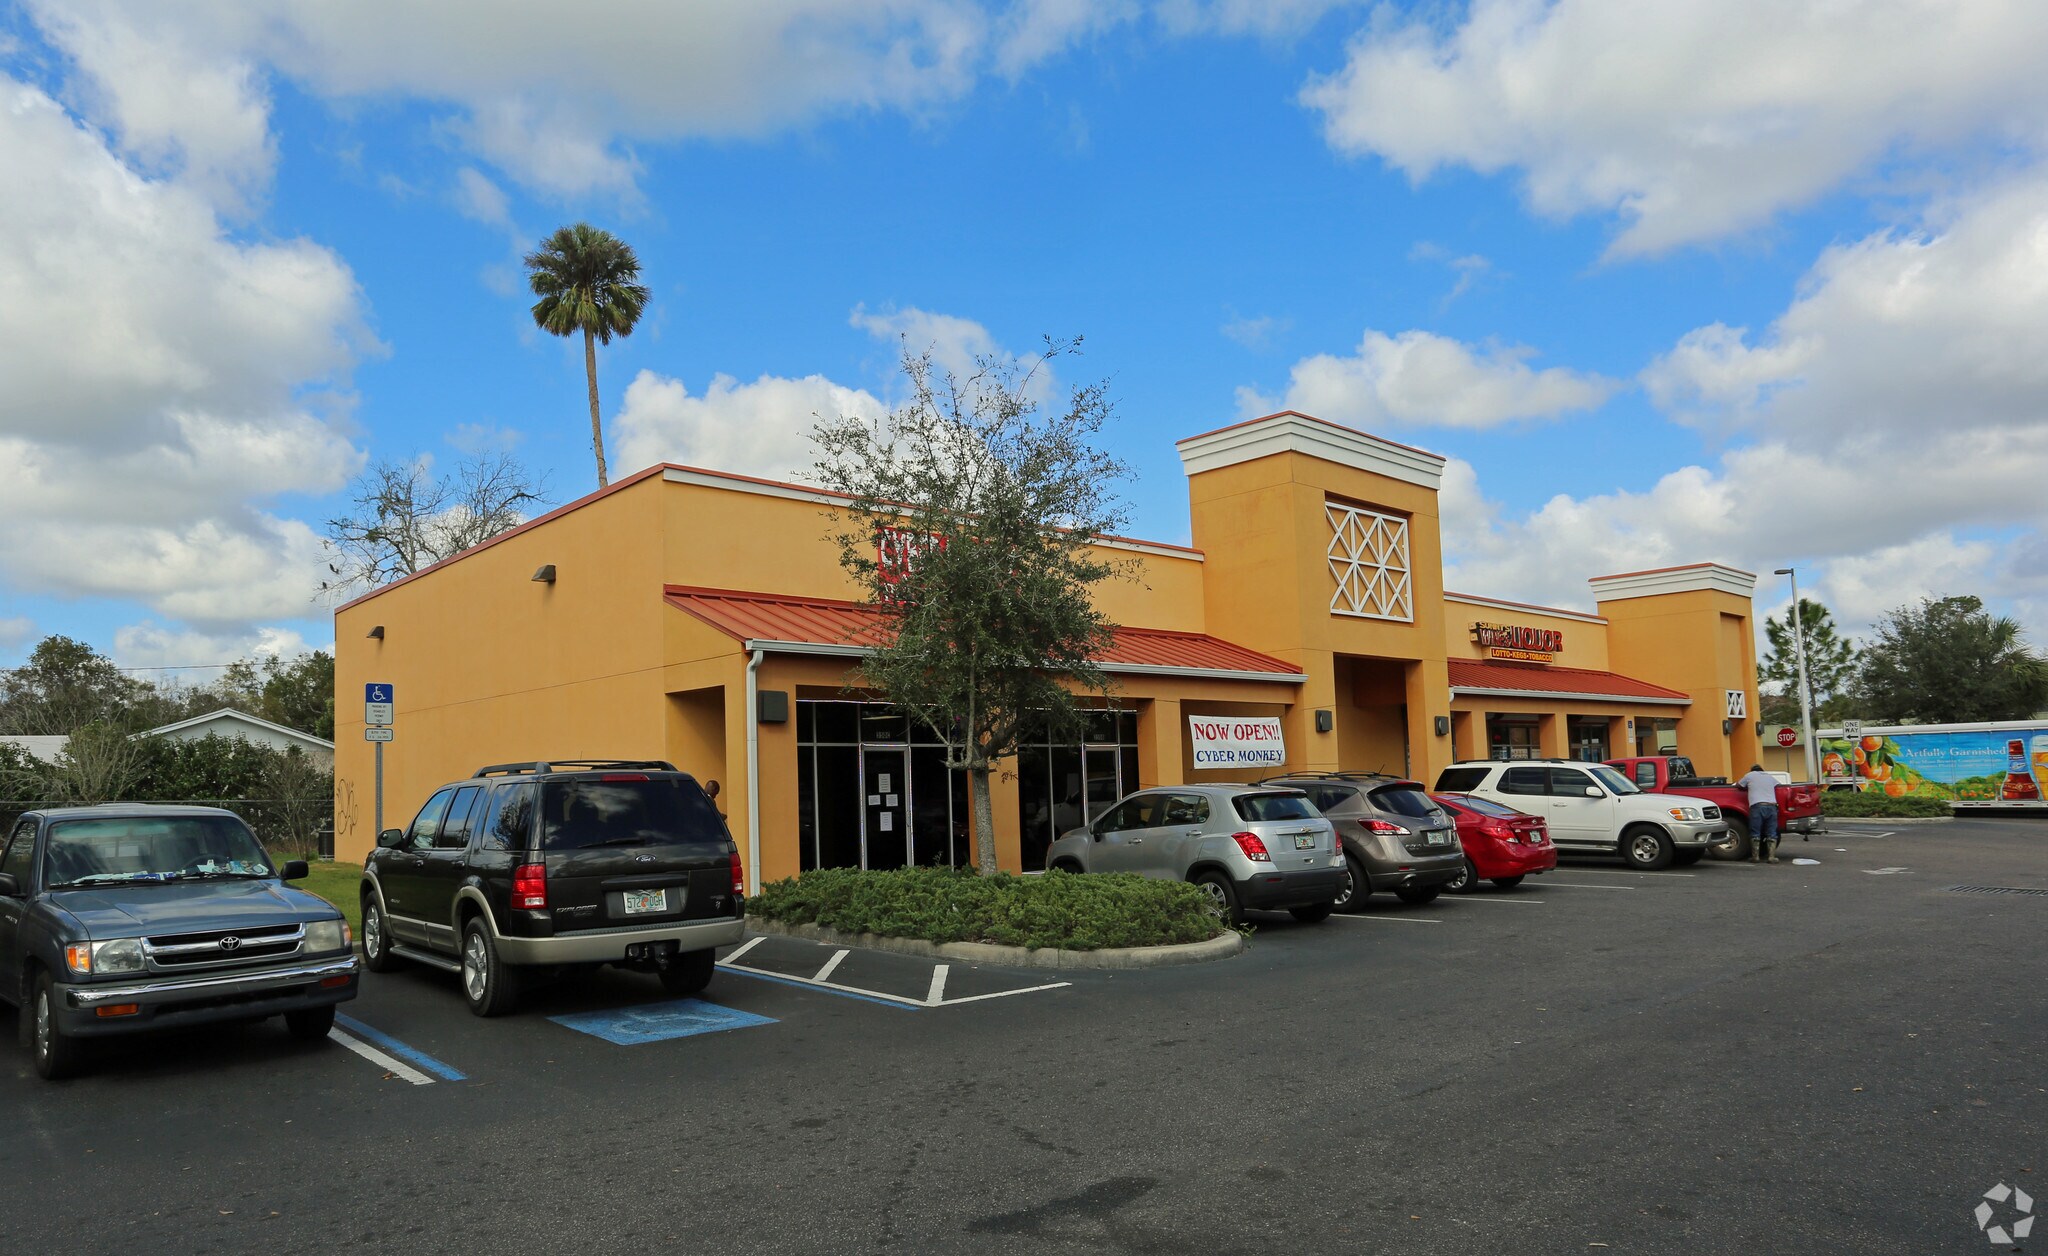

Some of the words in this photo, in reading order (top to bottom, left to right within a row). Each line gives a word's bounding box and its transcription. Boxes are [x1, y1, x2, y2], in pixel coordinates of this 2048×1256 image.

[1511, 626, 1563, 652] LIQUOR
[1193, 723, 1230, 740] NOW
[1233, 724, 1280, 741] OPEN!!
[1777, 733, 1796, 742] STOP
[1196, 750, 1235, 762] CYBER
[1238, 749, 1283, 763] MONKEY
[1905, 748, 1946, 758] Artfully
[1949, 746, 2007, 757] Garnished
[627, 896, 641, 909] 572
